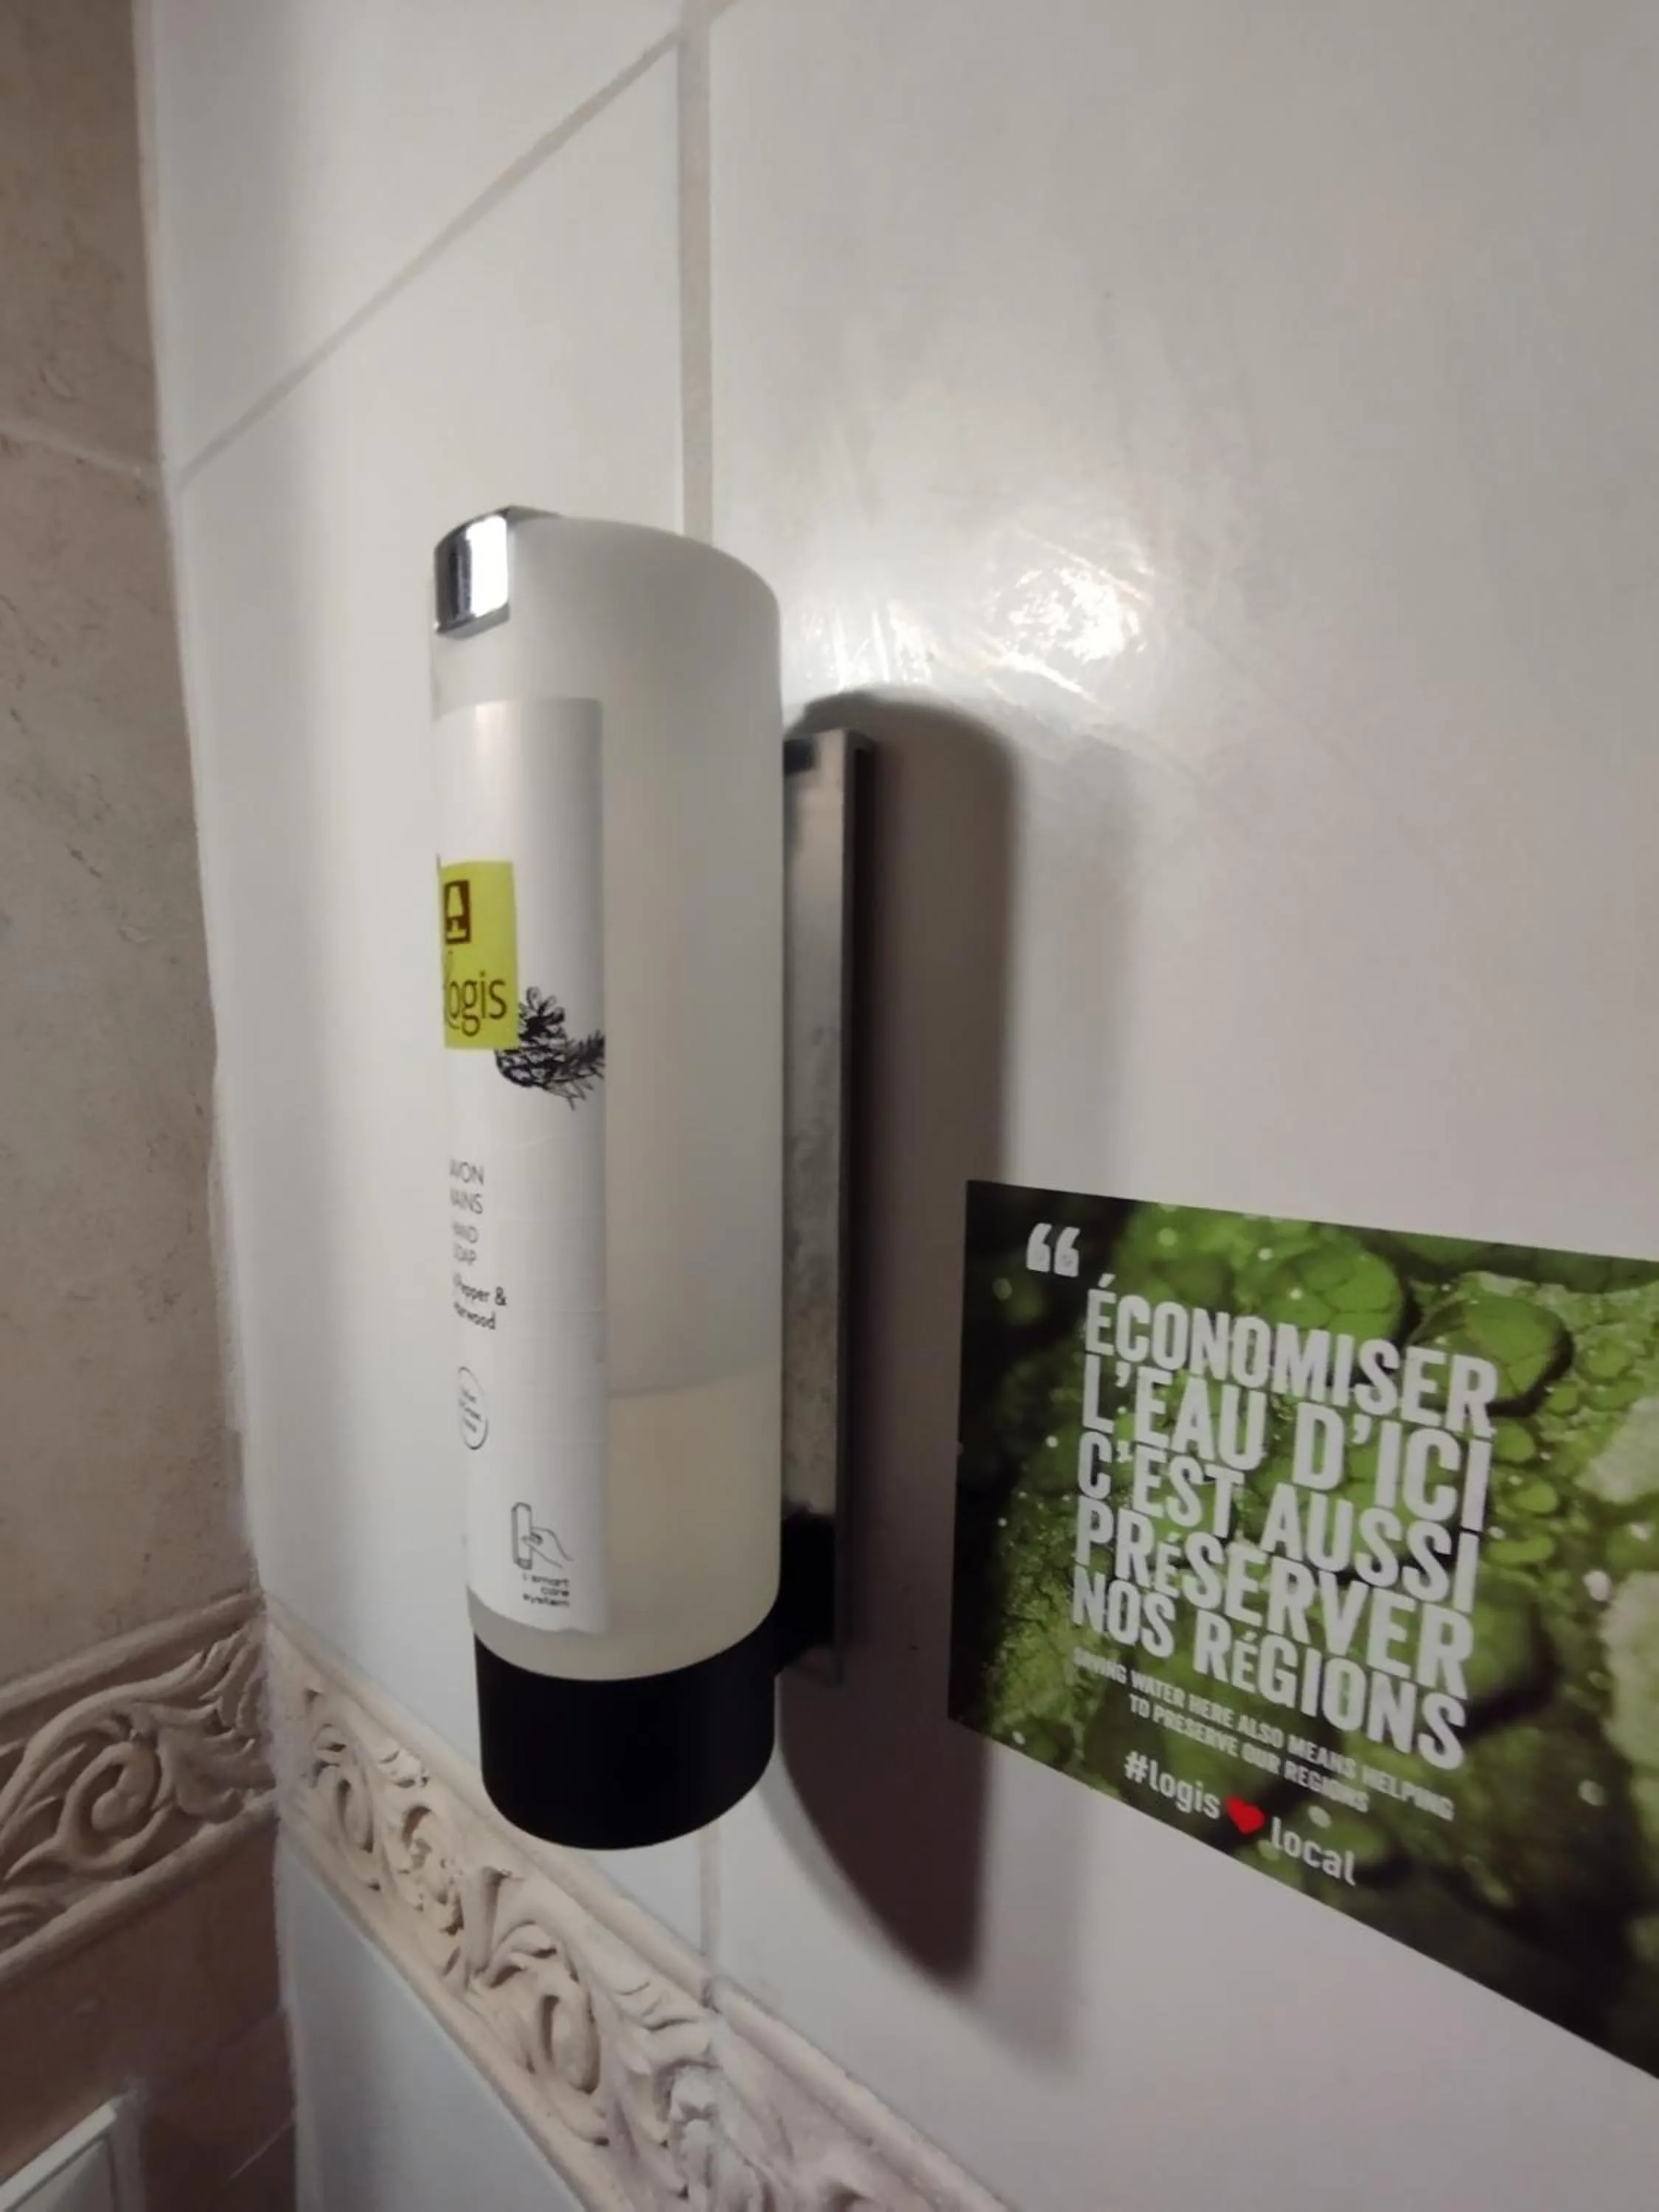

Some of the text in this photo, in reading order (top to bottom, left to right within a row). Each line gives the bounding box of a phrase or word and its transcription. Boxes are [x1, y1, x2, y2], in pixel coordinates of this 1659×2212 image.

[1085, 1273, 1497, 1438] ÉCONOMISER
[1077, 1432, 1479, 1613] C'EST AUSSI
[1082, 1354, 1492, 1532] L'EAU D'ICI
[1072, 1566, 1465, 1770] NOS RÉGIONS
[1074, 1498, 1474, 1700] PRÉSERVER
[1124, 1750, 1357, 1887] #logis local
[1129, 1693, 1370, 1814] TO PRESERVE OUR REGIONS
[1130, 1669, 1186, 1709] WATER
[1189, 1693, 1235, 1728] HERE
[1238, 1714, 1284, 1750] ALSO
[1287, 1733, 1357, 1779] MEANS
[1362, 1764, 1455, 1822] HELPING
